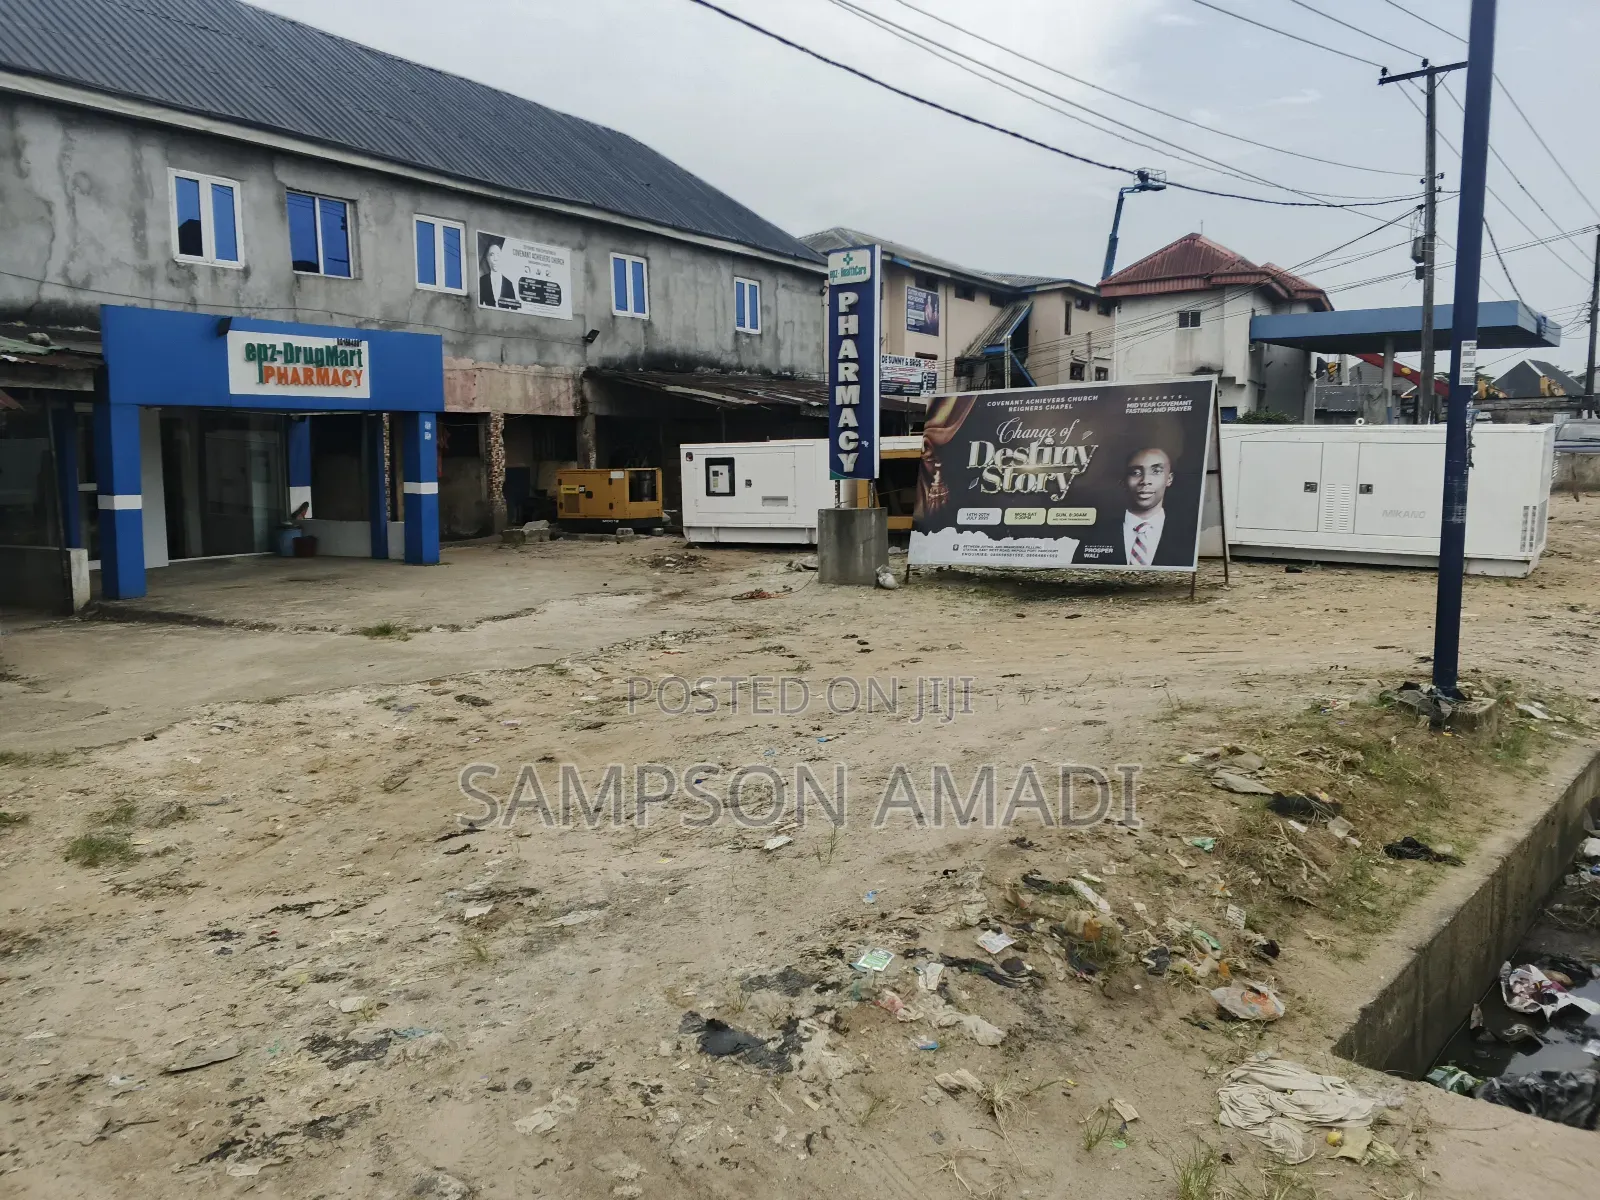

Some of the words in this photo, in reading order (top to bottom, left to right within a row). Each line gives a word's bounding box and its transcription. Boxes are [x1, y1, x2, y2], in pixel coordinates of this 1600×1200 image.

[244, 342, 364, 385] epz-DrugMart
[888, 356, 905, 366] SUNNY
[909, 358, 921, 368] BROS
[263, 365, 364, 388] PHARMACY
[835, 291, 861, 473] PHARMACY
[987, 399, 1024, 407] COVENANT
[1025, 397, 1065, 405] ACHIEVERS
[1067, 394, 1099, 403] CHURCH
[1008, 404, 1044, 413] REIGNERS
[1045, 402, 1073, 411] CHAPEL
[1125, 406, 1152, 414] FASTING
[1167, 405, 1193, 413] PRAYER
[1156, 399, 1193, 407] COVENANT
[996, 416, 1058, 445] Change
[1059, 418, 1080, 445] of
[966, 437, 1099, 474] Destiny
[980, 465, 1076, 502] Story
[1382, 509, 1426, 519] MIKANO
